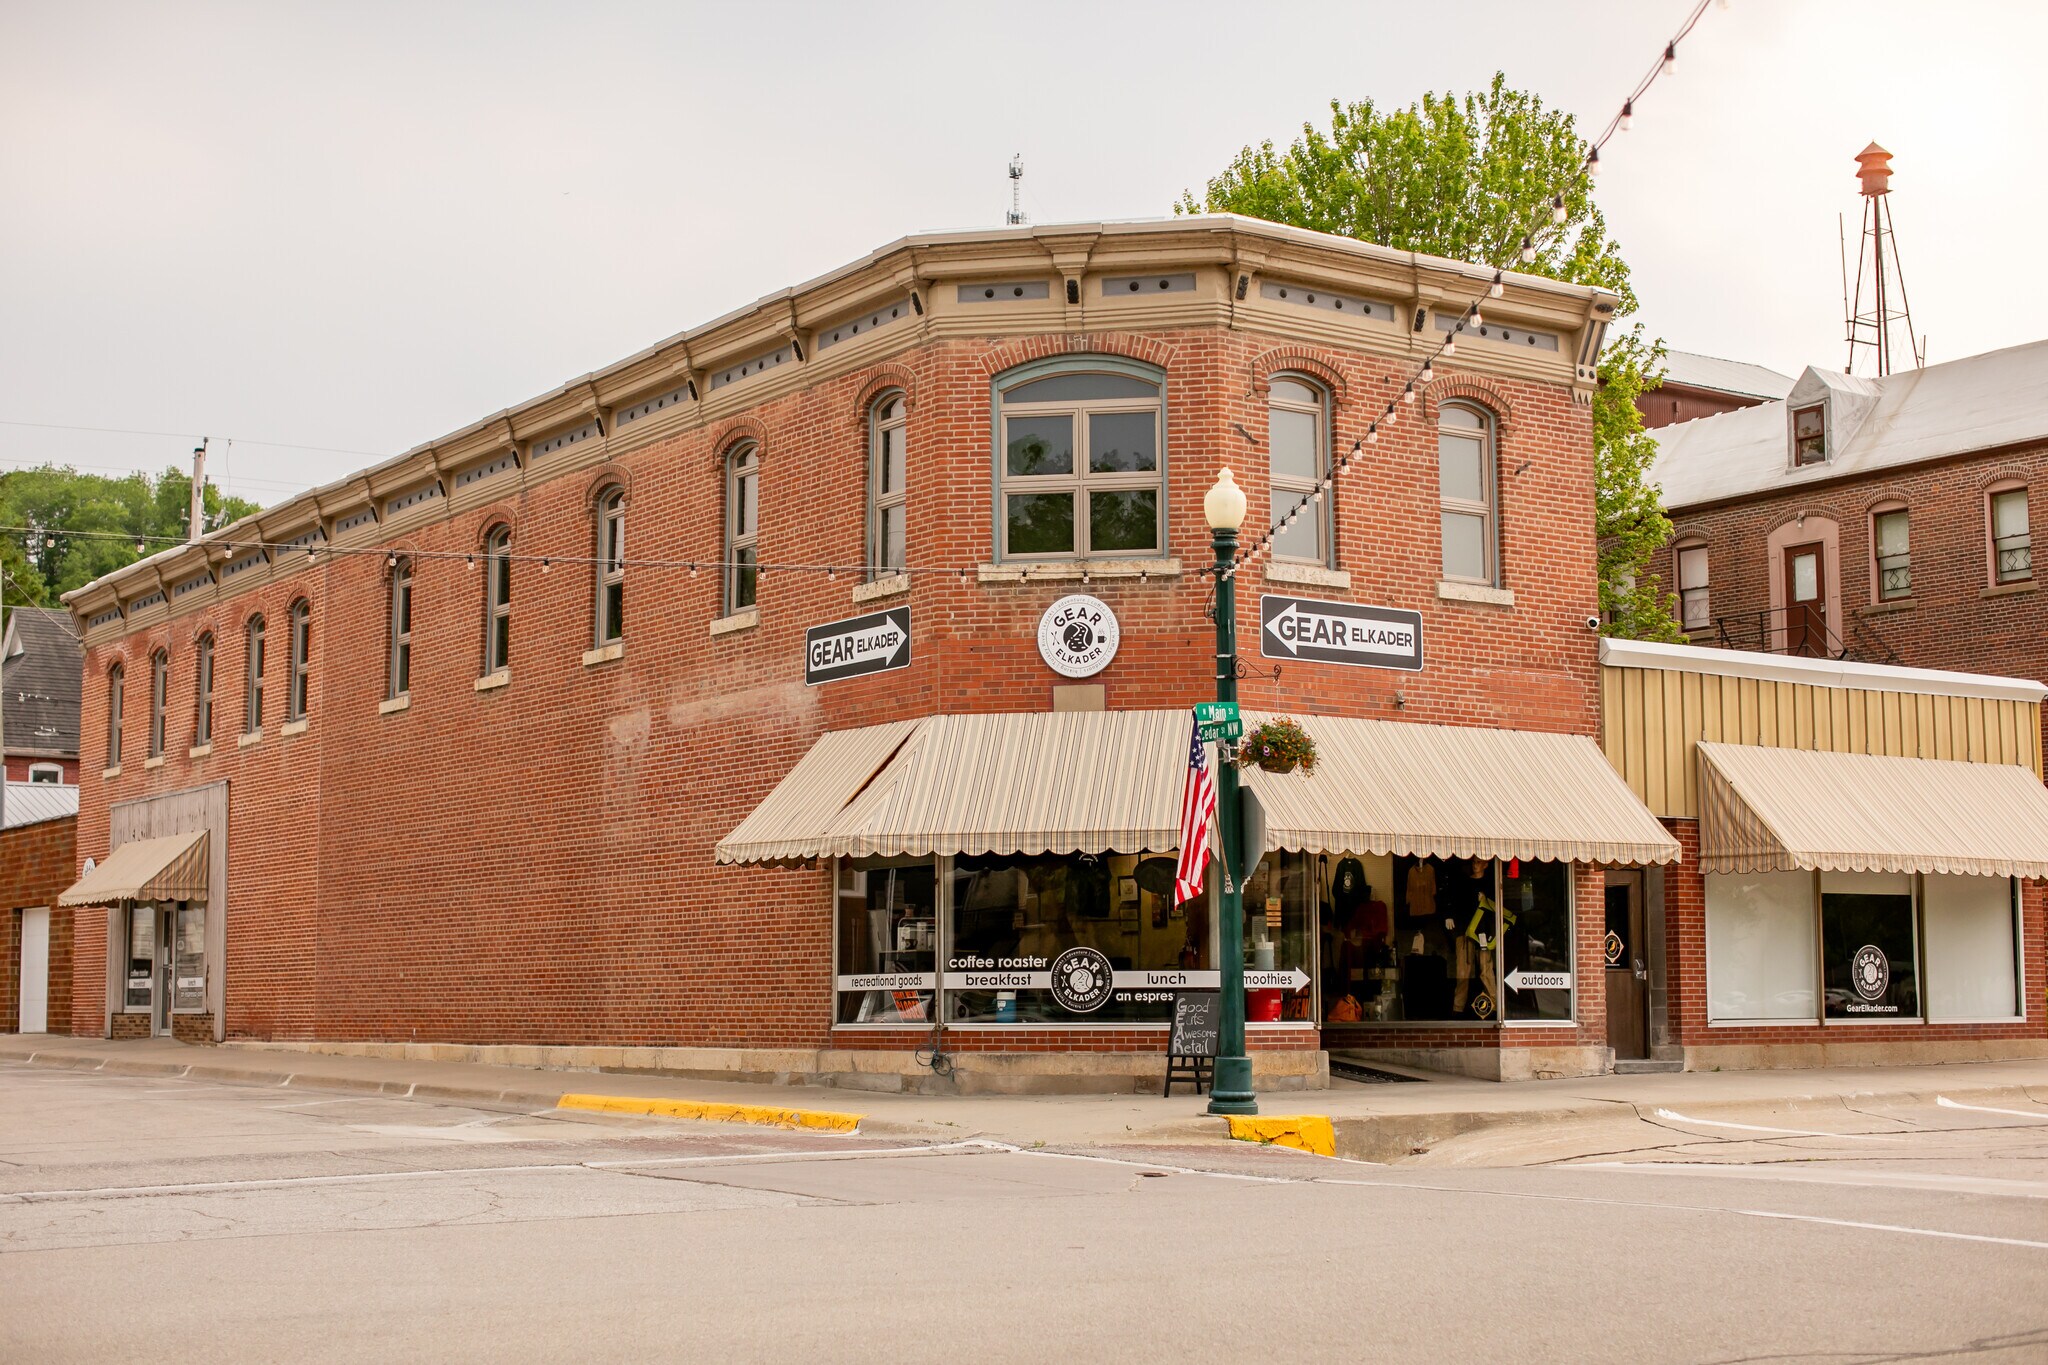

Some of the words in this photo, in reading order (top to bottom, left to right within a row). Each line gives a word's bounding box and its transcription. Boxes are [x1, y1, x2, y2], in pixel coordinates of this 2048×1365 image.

[1053, 607, 1102, 628] GEAR
[1278, 615, 1347, 647] GEAR
[1351, 627, 1413, 648] ELKADER
[811, 637, 855, 667] GEAR
[856, 631, 900, 654] ELKADER
[1055, 647, 1103, 665] ELKADER
[1208, 704, 1227, 721] Main
[1199, 726, 1219, 740] Cedar
[1227, 721, 1239, 736] NW
[949, 955, 996, 969] coffee
[998, 955, 1048, 969] roaster
[1062, 957, 1100, 974] GEAR
[1859, 953, 1881, 967] GEAR
[851, 974, 897, 988] recreational
[898, 974, 923, 989] goods
[965, 974, 1032, 986] breakfast
[1147, 972, 1187, 985] lunch
[1244, 972, 1293, 985] moothies
[1521, 974, 1564, 986] outdoors
[1860, 980, 1882, 991] ELKADER
[1063, 988, 1101, 1002] ELKADER
[1116, 993, 1132, 1001] an
[1135, 993, 1176, 1003] espres
[1176, 997, 1211, 1014] Good
[1846, 1004, 1898, 1013] GearElkader.com
[1175, 1012, 1205, 1026] Eats
[1173, 1025, 1217, 1040] Awesome
[1173, 1038, 1209, 1054] Retail
